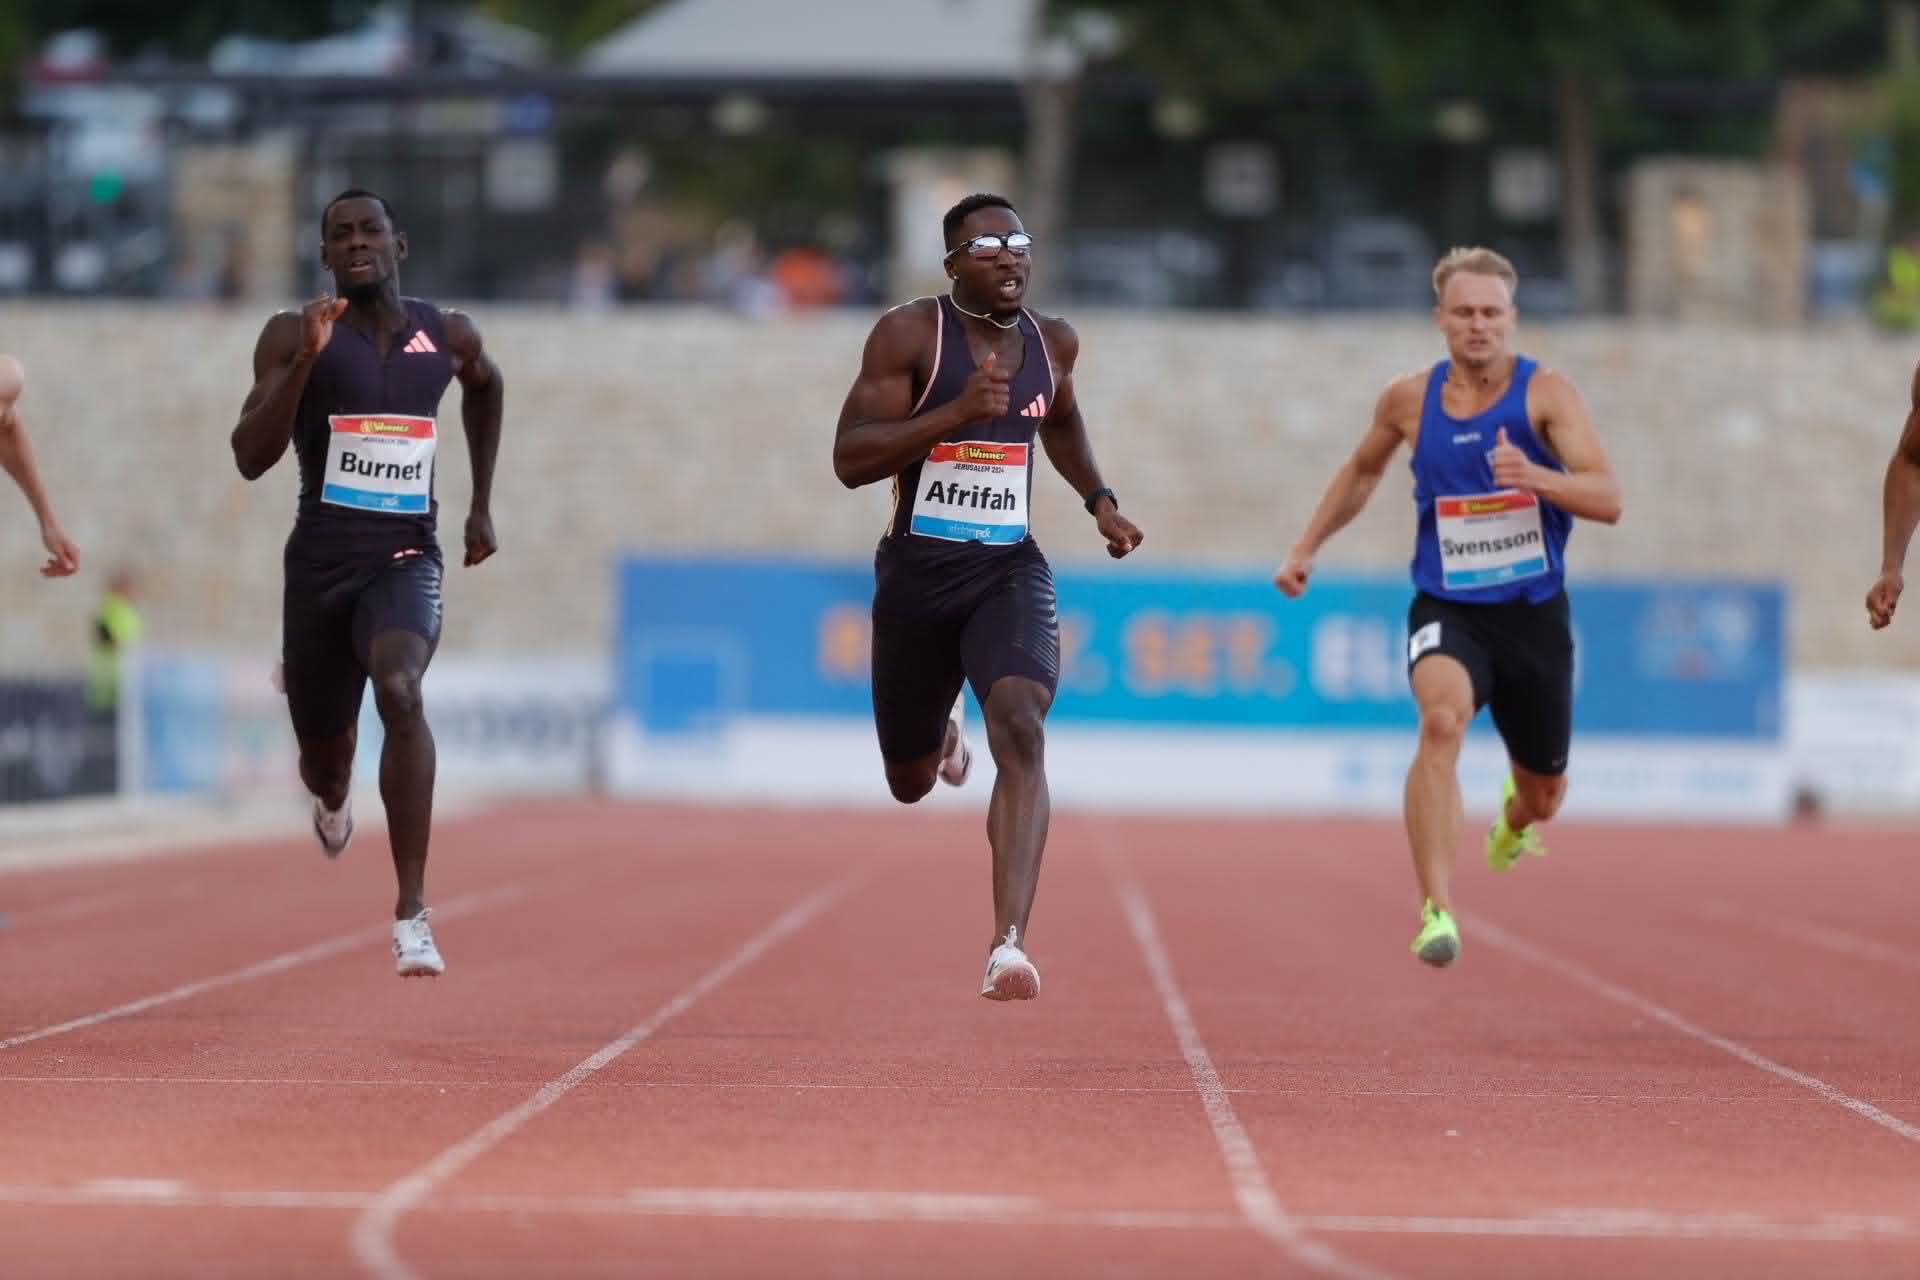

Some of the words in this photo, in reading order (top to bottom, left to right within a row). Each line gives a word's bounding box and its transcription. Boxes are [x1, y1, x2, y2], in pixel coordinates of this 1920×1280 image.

[340, 451, 421, 480] Burnet
[953, 462, 990, 473] JERUSALEM
[925, 480, 1016, 511] Afrifah
[1442, 529, 1540, 557] Svensson
